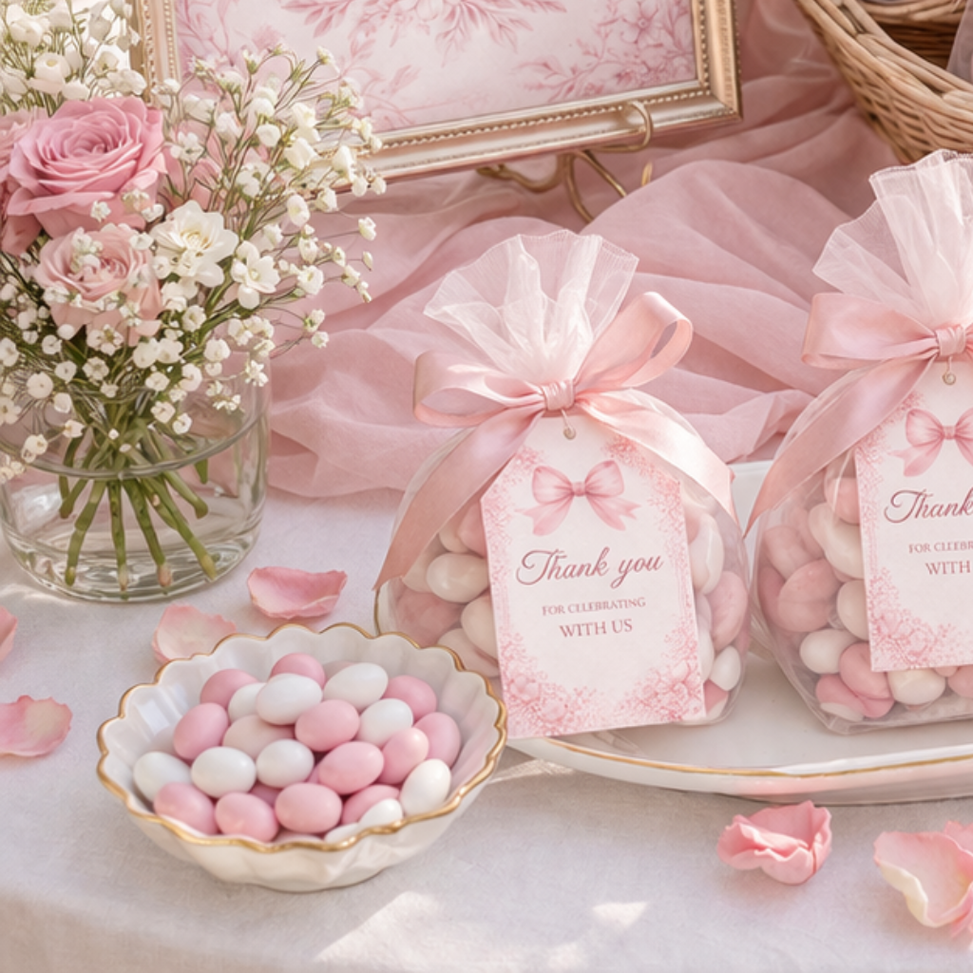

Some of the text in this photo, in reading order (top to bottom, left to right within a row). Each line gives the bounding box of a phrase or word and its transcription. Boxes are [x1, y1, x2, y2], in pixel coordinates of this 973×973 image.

[908, 543, 931, 554] FOR
[515, 546, 664, 589] Thank you
[925, 559, 971, 575] WITH
[542, 604, 565, 616] FOR
[559, 618, 633, 638] WITH US
